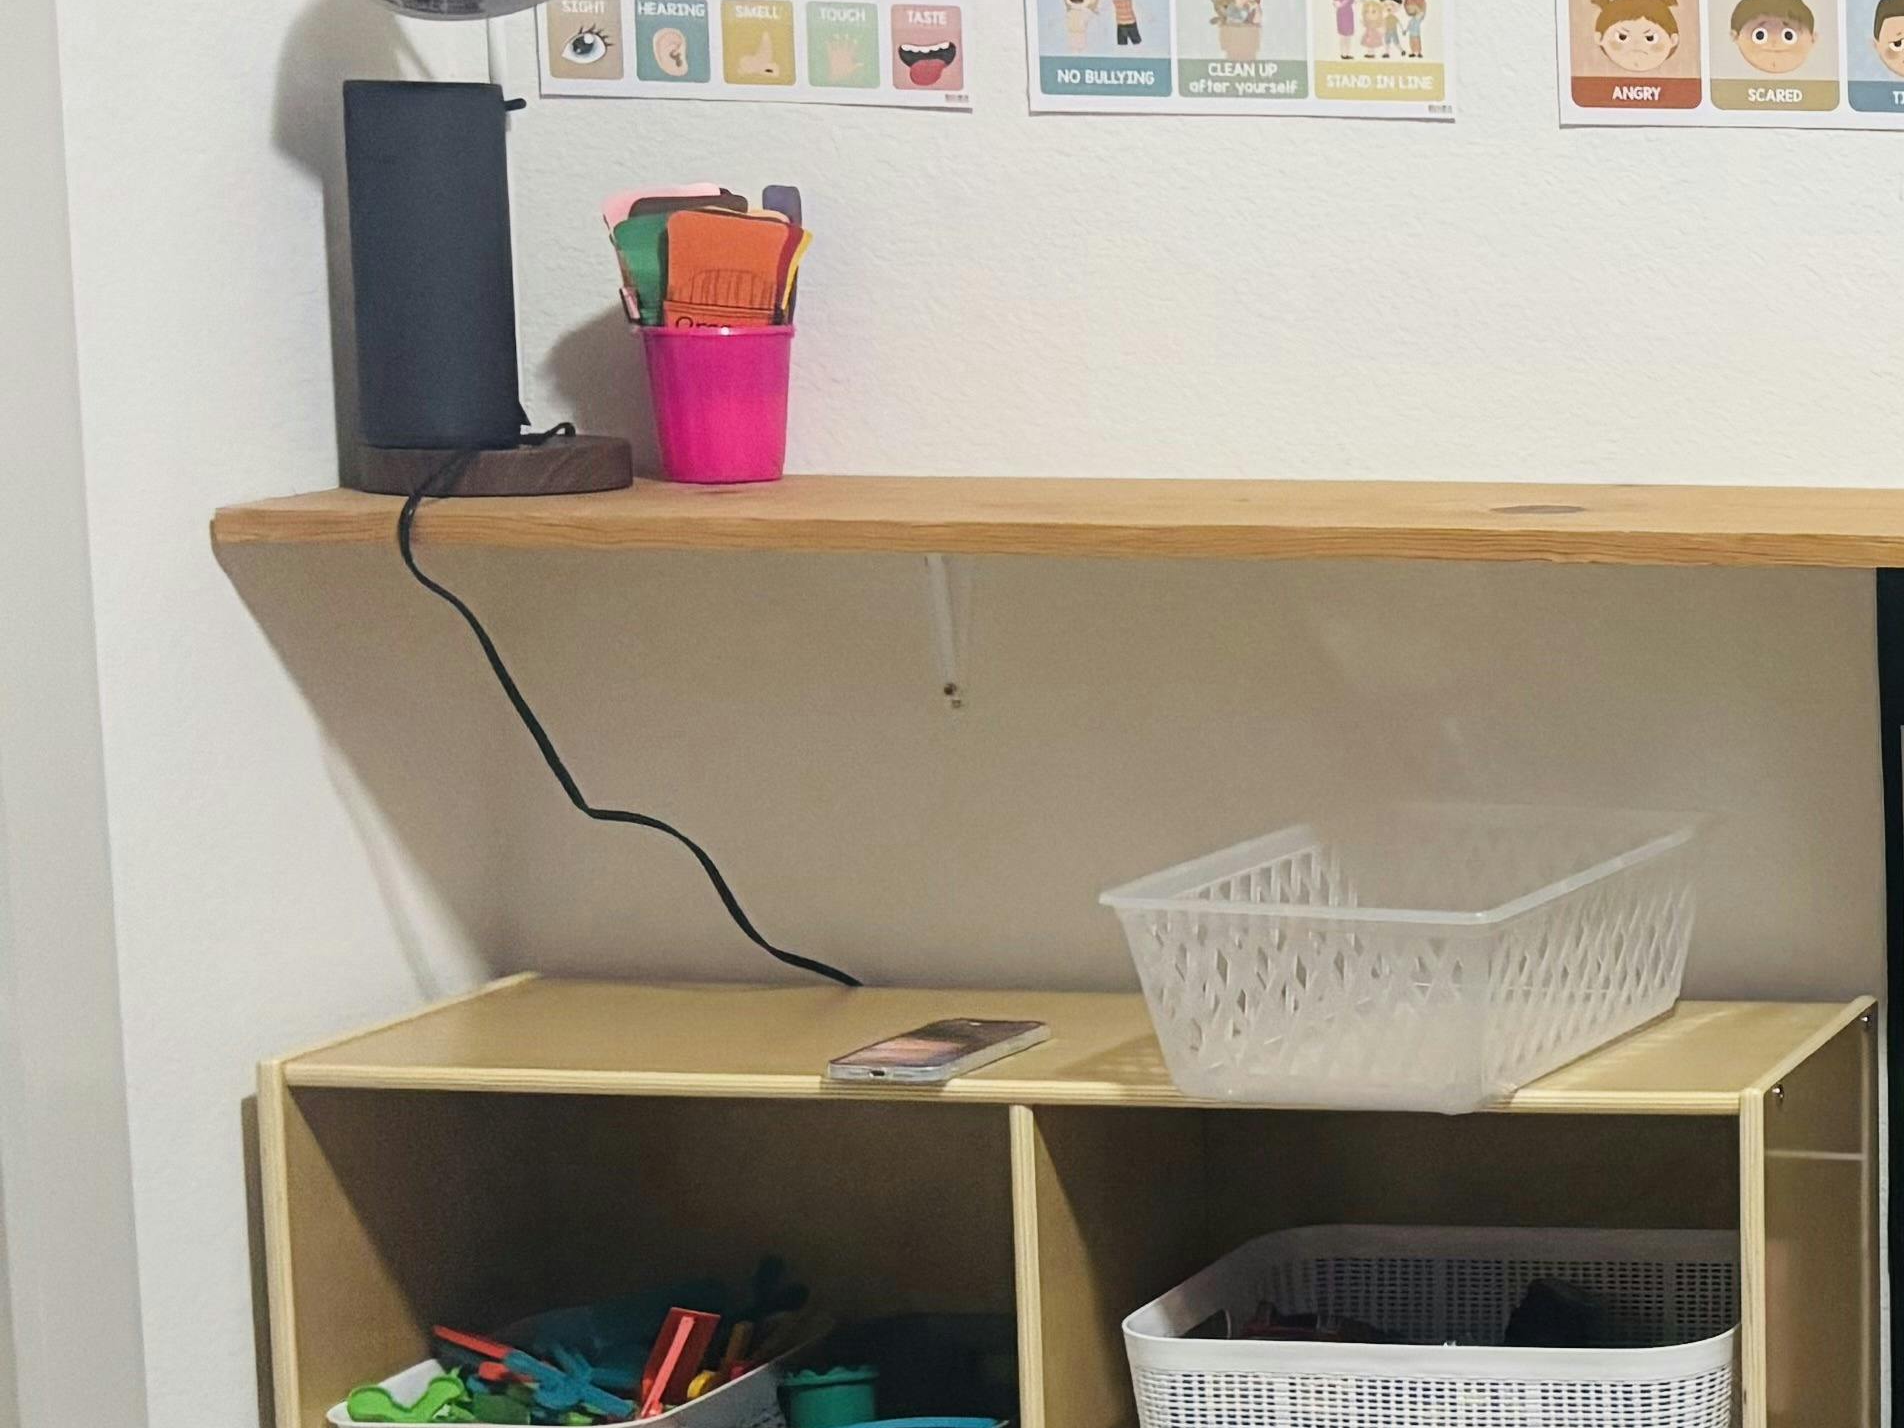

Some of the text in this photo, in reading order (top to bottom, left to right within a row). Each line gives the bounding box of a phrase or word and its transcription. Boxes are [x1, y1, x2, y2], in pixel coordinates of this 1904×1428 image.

[638, 1, 705, 18] HEARING
[1057, 69, 1155, 86] NO BULLYING
[1612, 87, 1661, 101] ANGRY
[1748, 89, 1802, 103] SCARED
